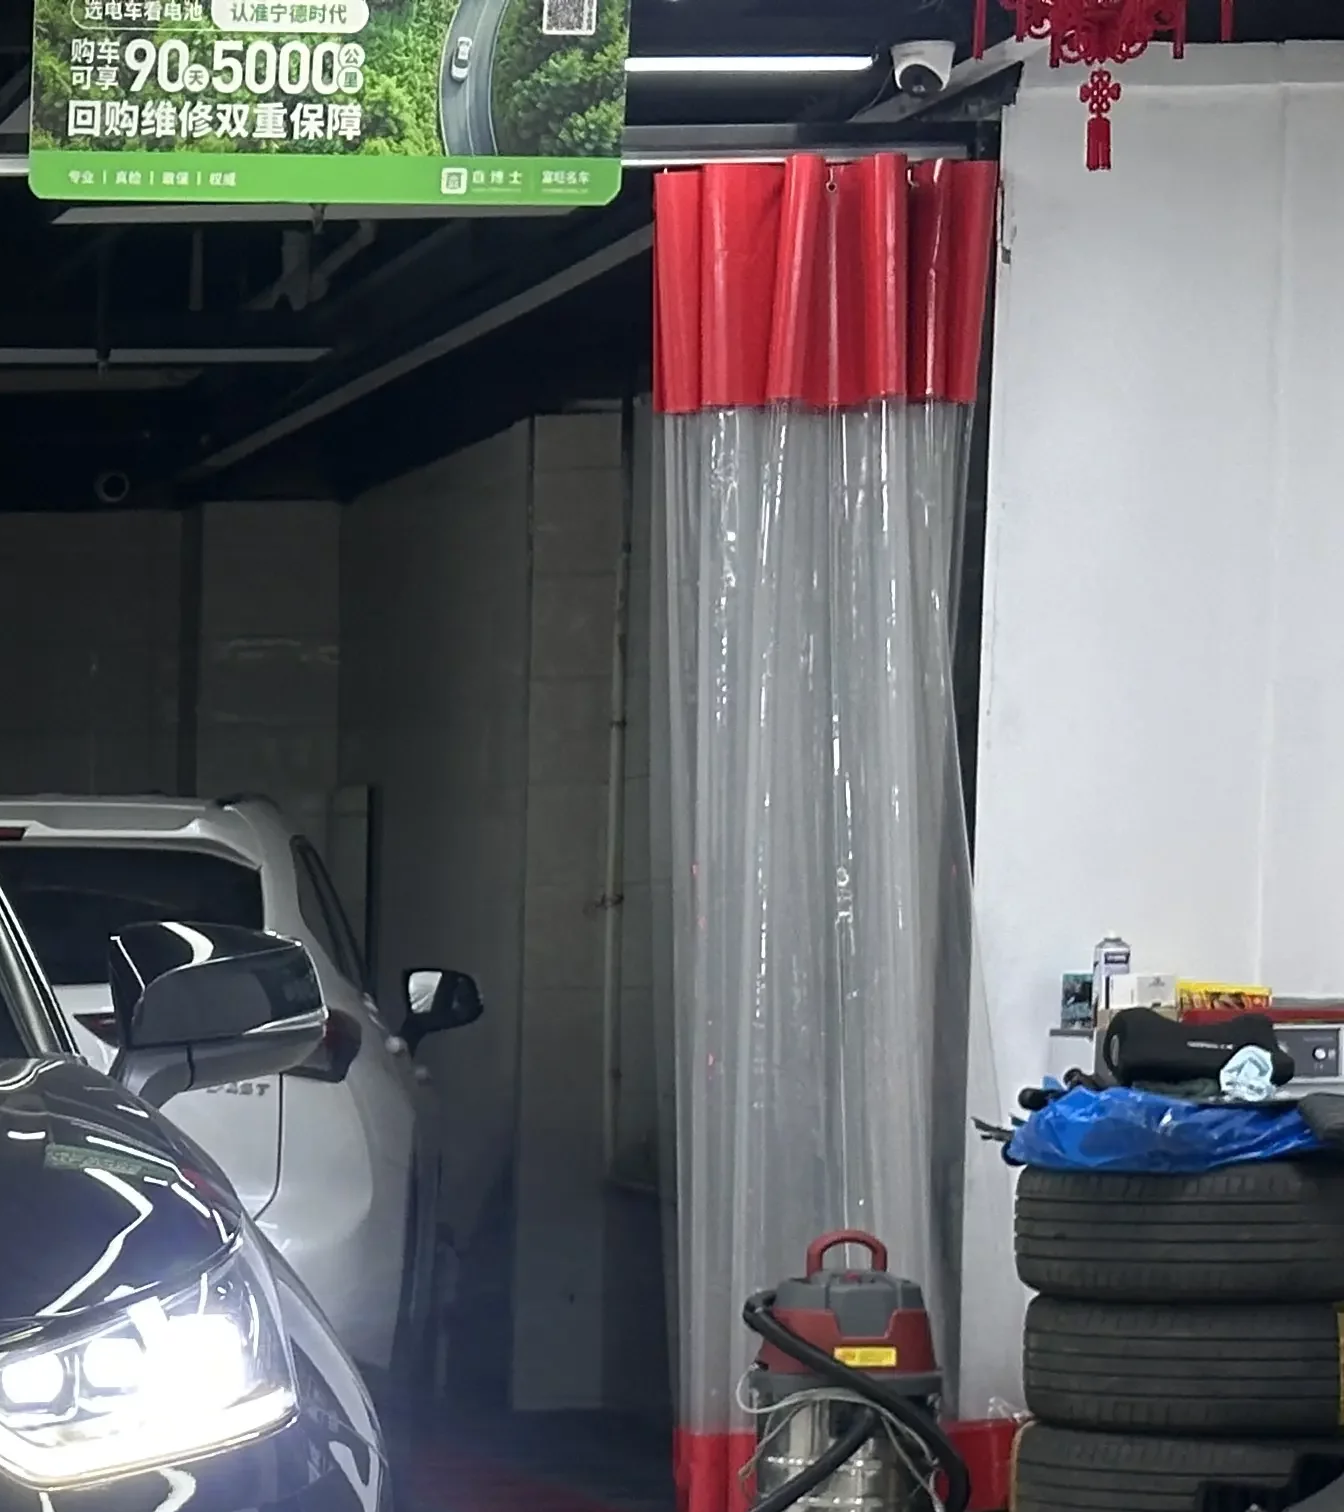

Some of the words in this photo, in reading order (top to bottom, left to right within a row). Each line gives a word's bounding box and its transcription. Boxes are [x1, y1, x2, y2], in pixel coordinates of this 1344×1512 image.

[84, 0, 203, 21] 选电车看电池
[230, 3, 348, 24] 认准宁德时代
[71, 38, 121, 64] 购车
[71, 65, 120, 91] 可享
[67, 100, 363, 140] 回购维修双重保障
[541, 170, 591, 185] 富旺名车
